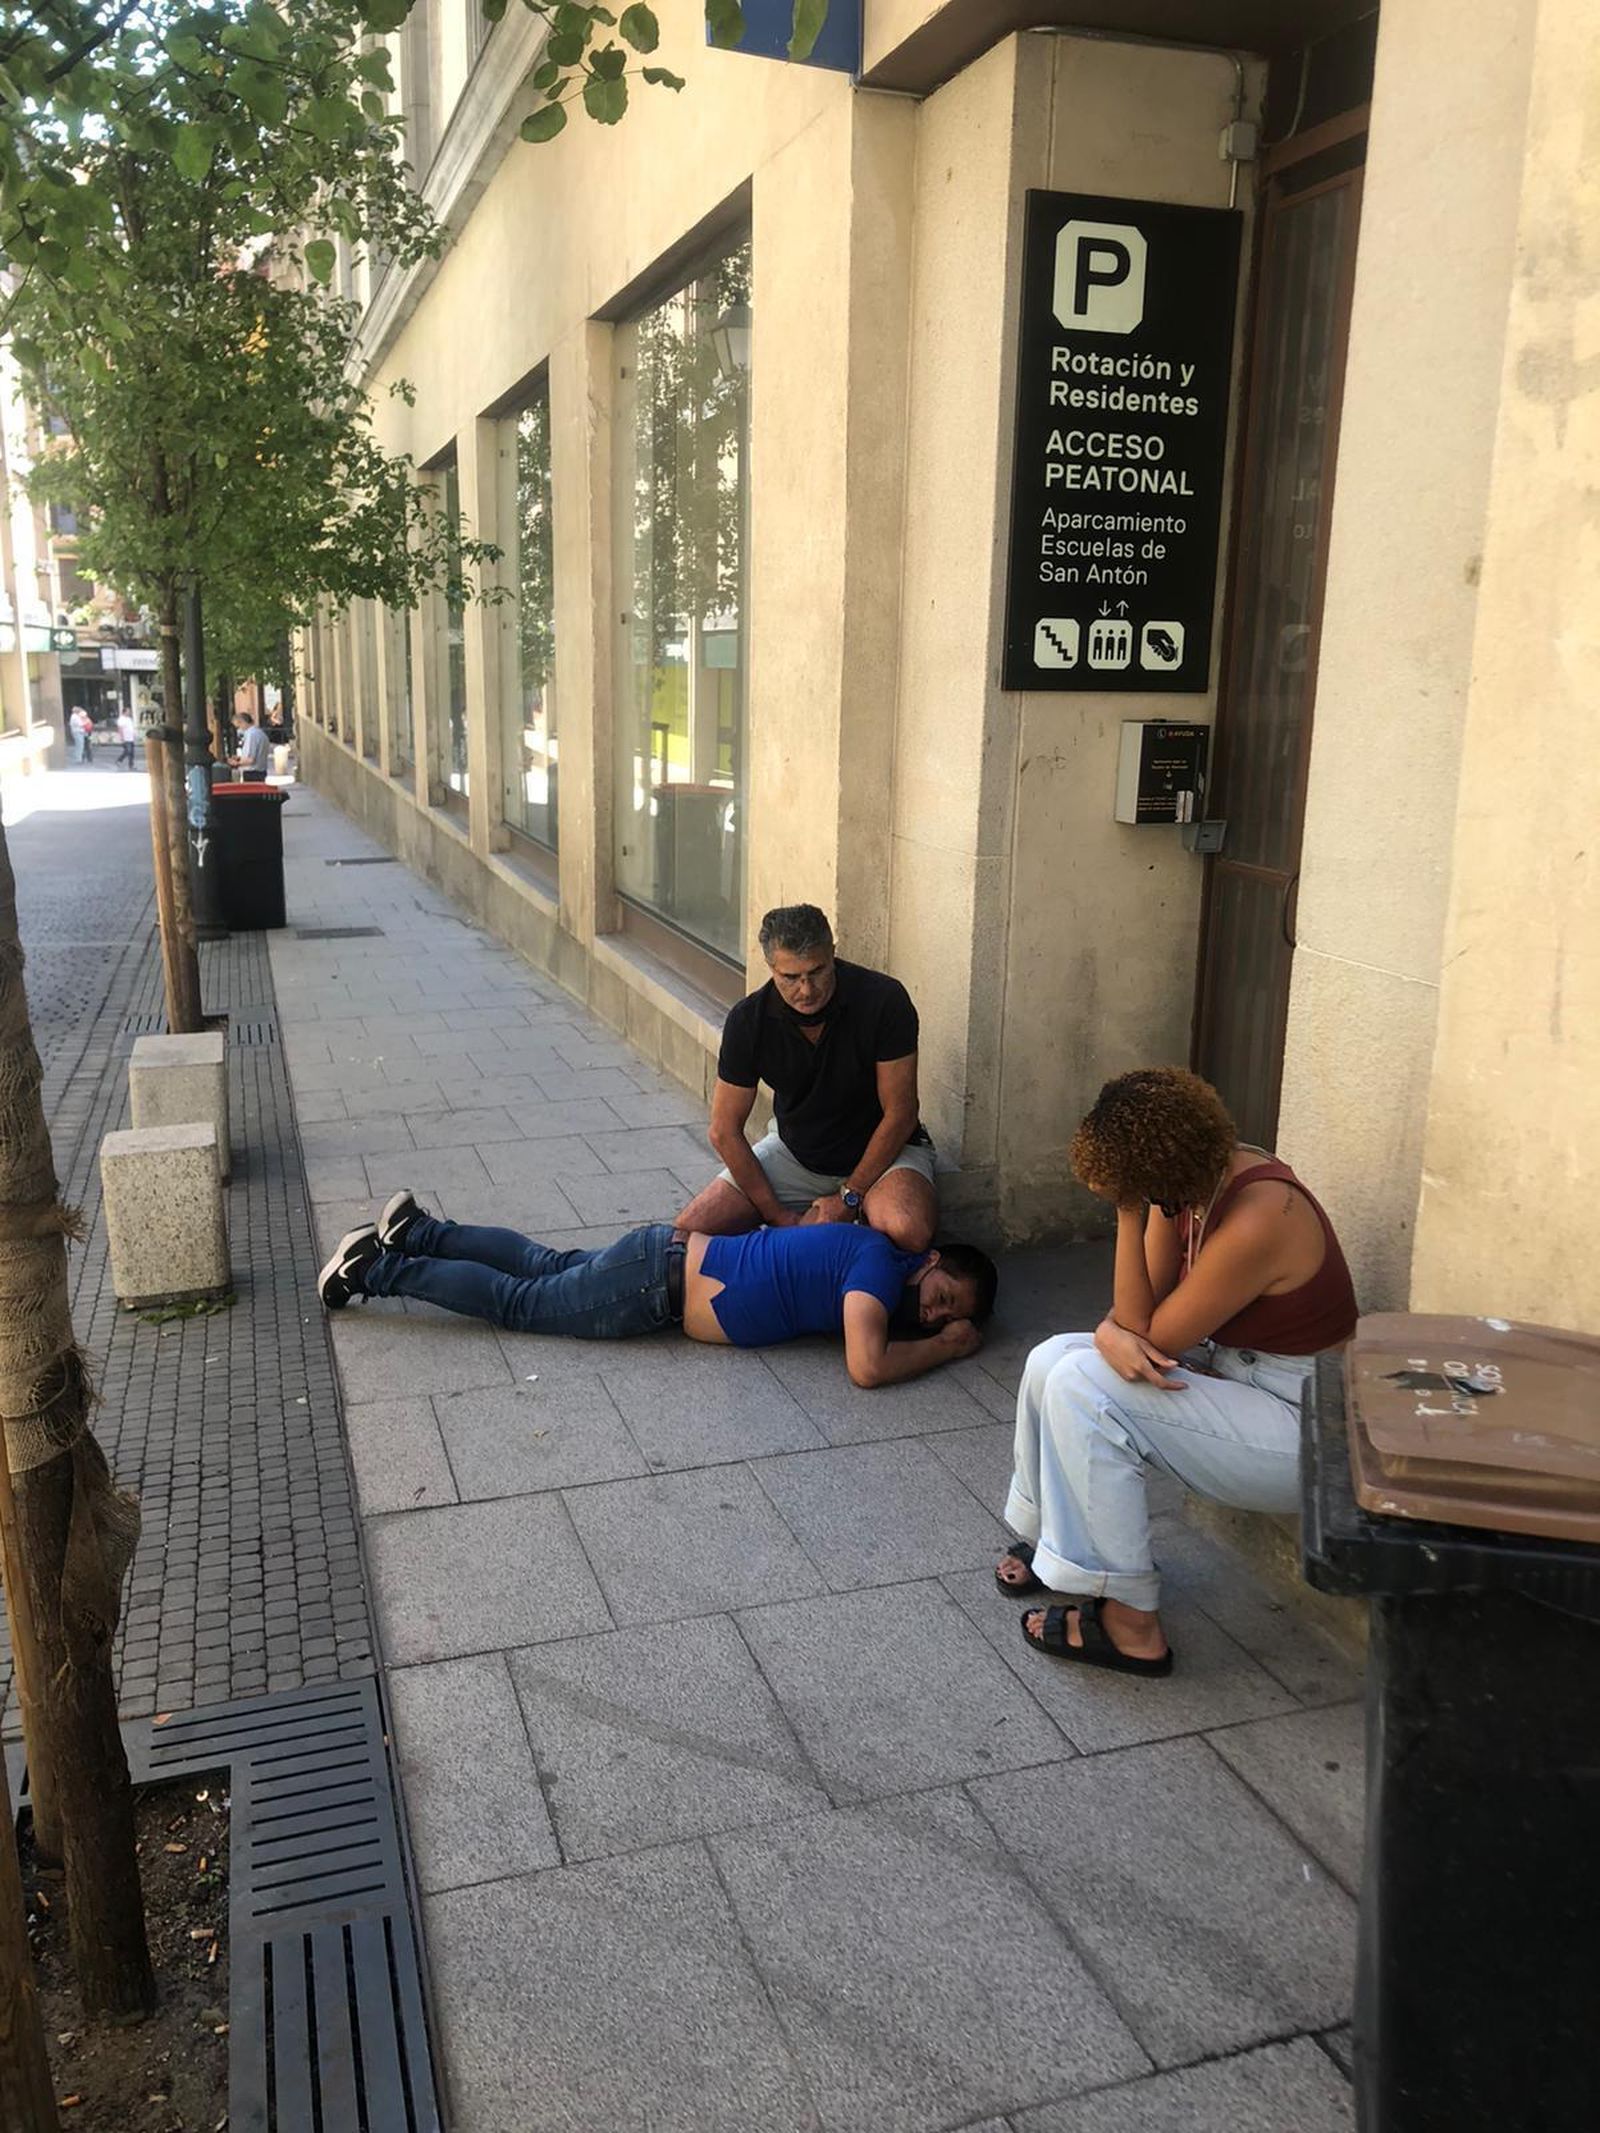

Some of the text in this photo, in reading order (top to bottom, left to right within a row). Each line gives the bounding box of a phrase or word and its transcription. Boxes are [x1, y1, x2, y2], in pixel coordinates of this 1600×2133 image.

[1074, 236, 1131, 315] P
[1051, 346, 1196, 388] Rotación y
[1049, 380, 1199, 416] Residentes
[1045, 429, 1165, 461] ACCESO
[1045, 462, 1194, 496] PEATONAL
[1041, 506, 1187, 534] Aparcamiento
[1041, 533, 1166, 560] Escuelas de
[1039, 561, 1148, 586] San Antón
